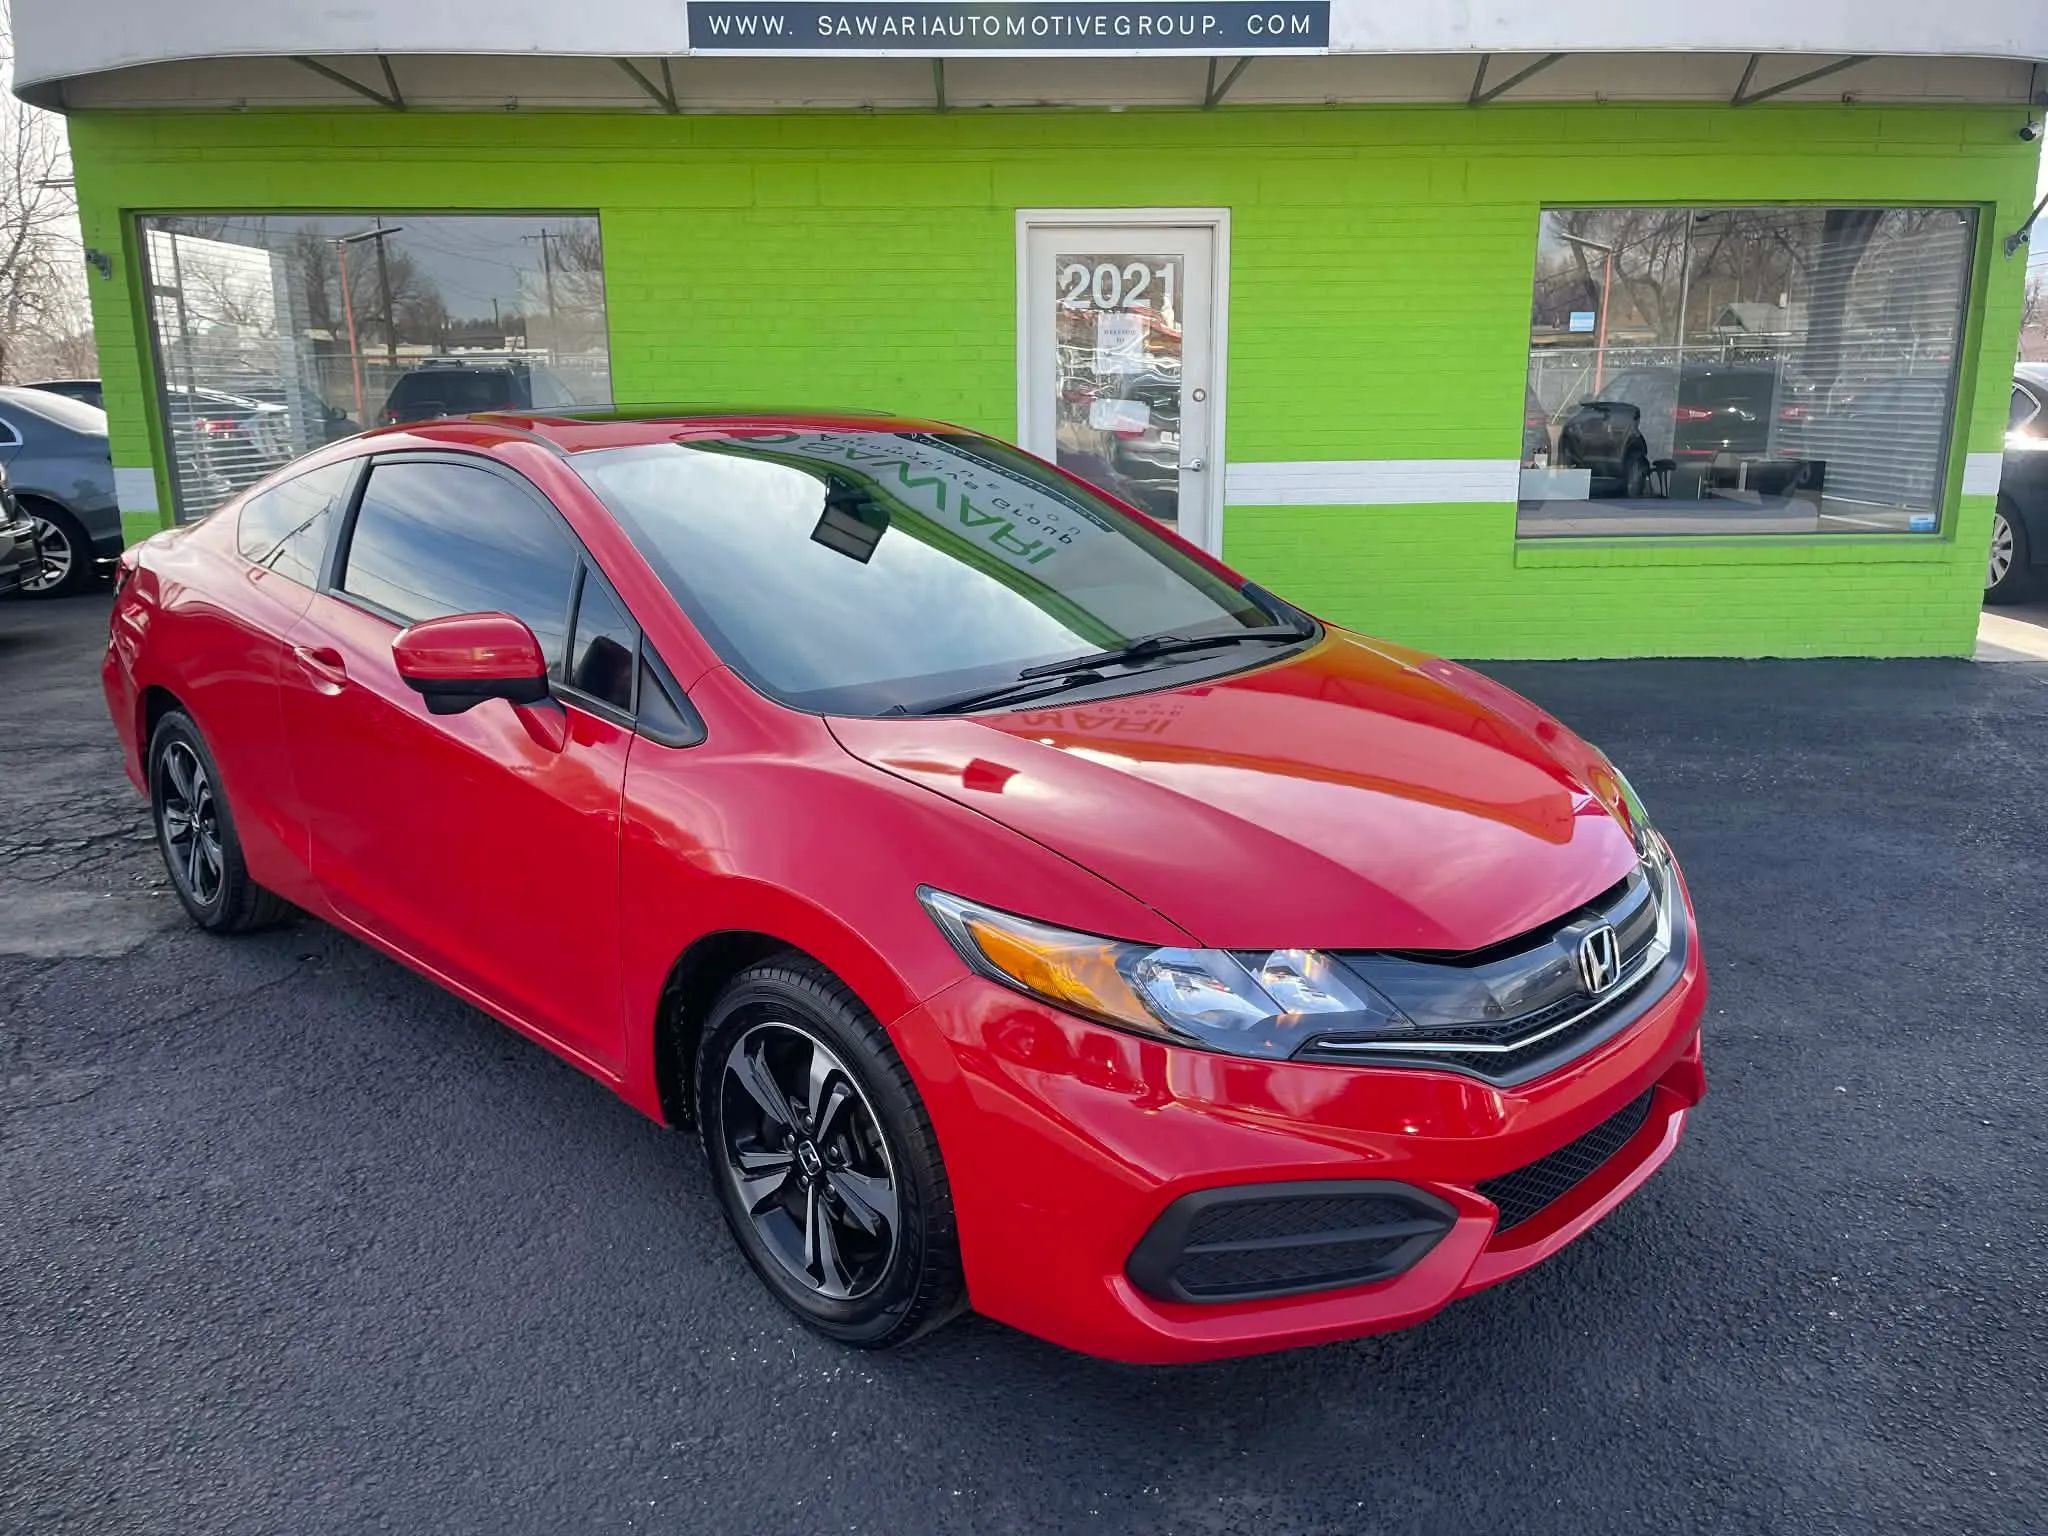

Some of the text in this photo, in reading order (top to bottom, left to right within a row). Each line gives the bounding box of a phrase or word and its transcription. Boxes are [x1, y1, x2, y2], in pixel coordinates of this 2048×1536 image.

[708, 13, 1312, 37] WWW. SAWARIAUTOMOTIVEGROUP. COM
[1062, 262, 1174, 309] 2021
